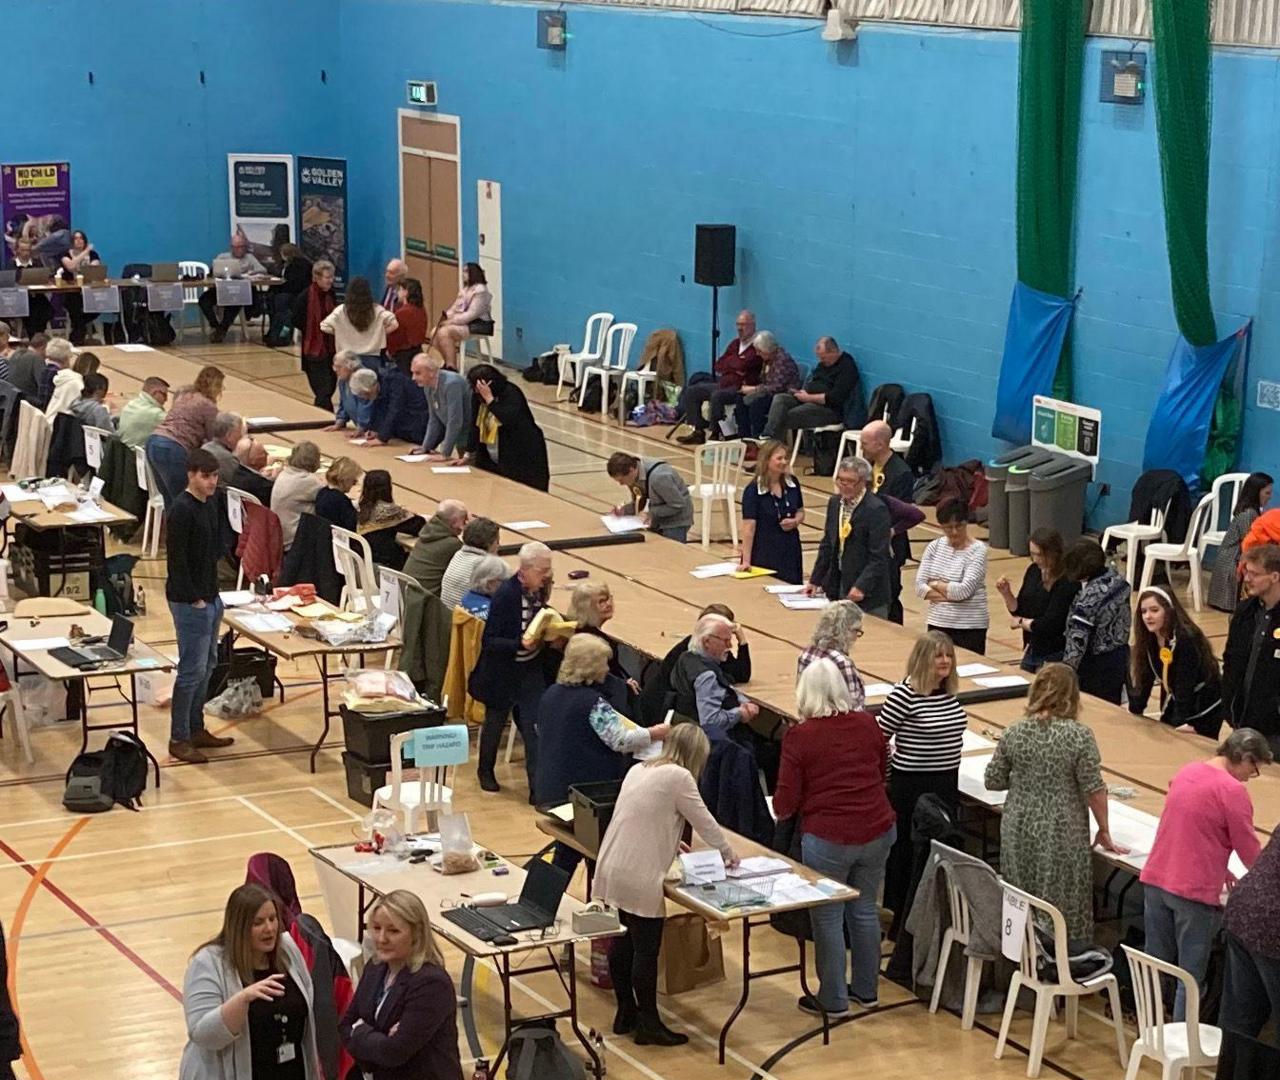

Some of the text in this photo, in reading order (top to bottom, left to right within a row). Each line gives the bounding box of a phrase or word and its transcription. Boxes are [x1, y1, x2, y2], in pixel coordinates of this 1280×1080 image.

[17, 167, 56, 179] NO CHLD
[311, 167, 344, 178] GOLDEN
[17, 179, 34, 187] LEFT
[312, 176, 344, 188] VALLEY
[385, 590, 391, 604] 7
[1005, 917, 1013, 936] 8
